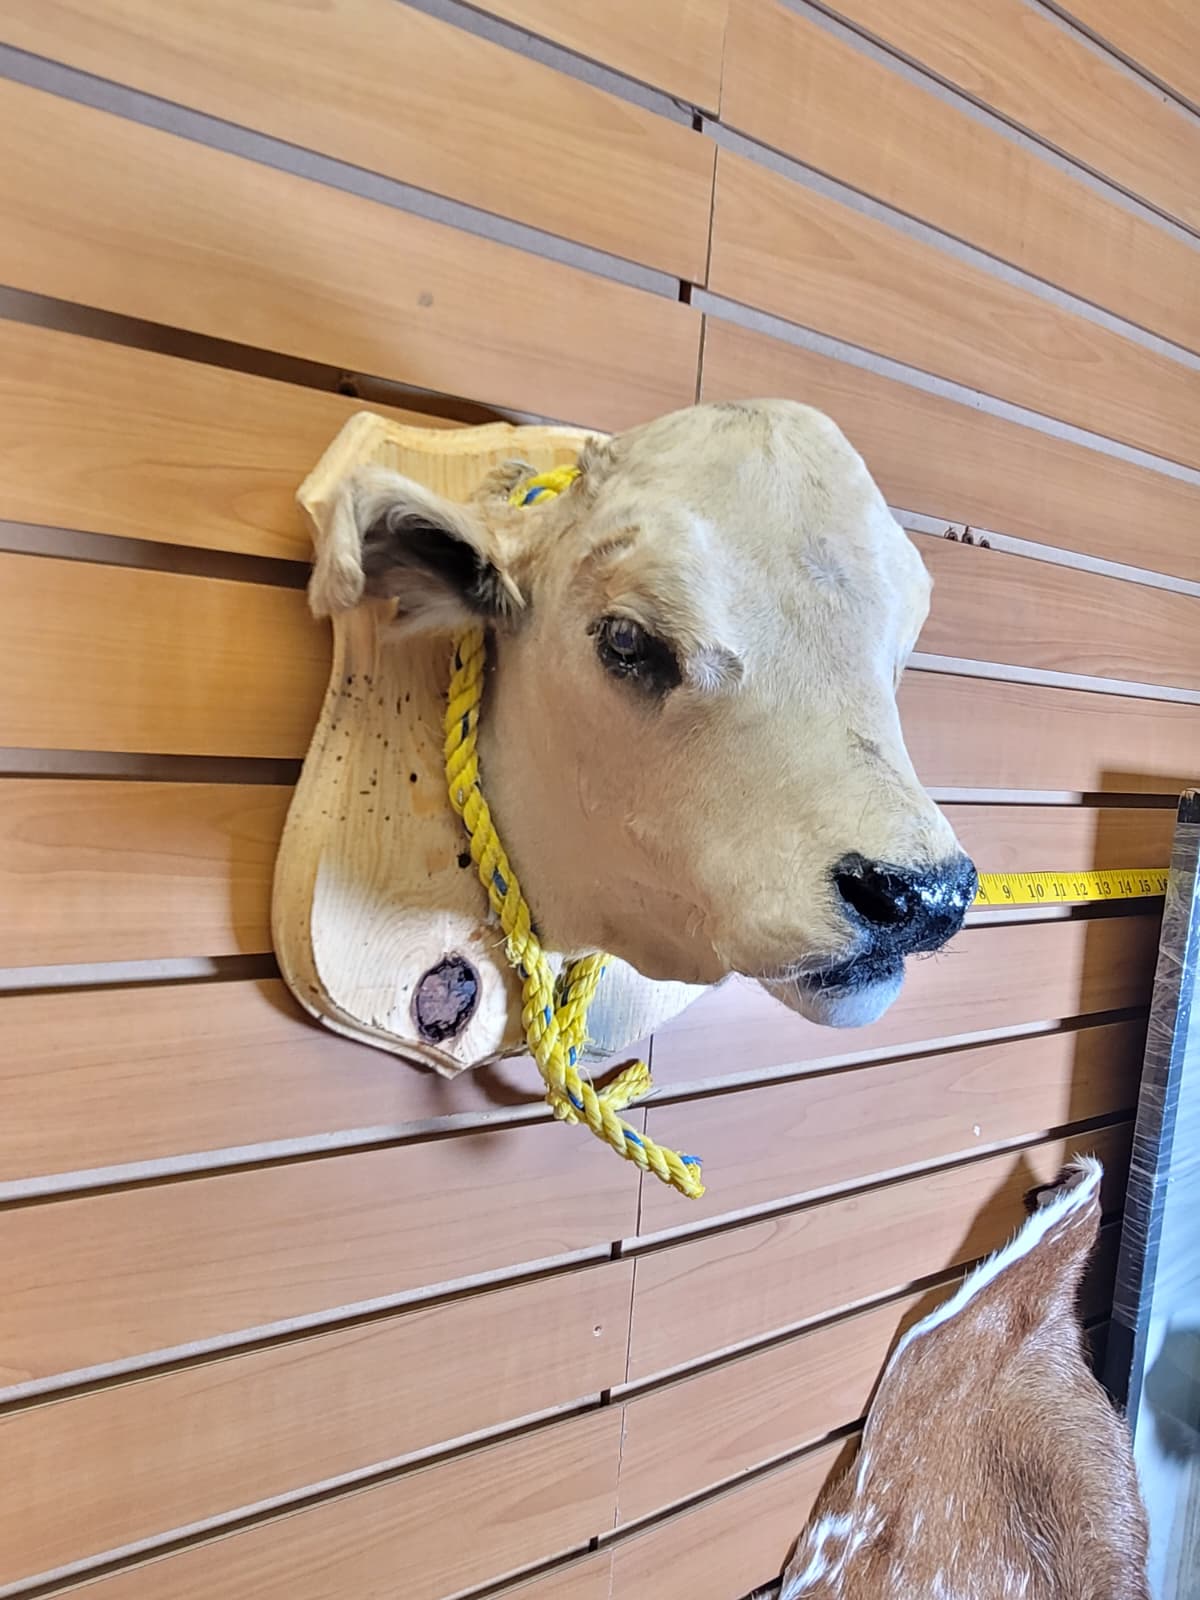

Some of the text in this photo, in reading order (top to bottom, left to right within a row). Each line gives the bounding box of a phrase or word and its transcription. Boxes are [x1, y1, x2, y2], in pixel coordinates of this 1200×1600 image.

[978, 885, 986, 899] 8
[1002, 884, 1011, 899] 9
[1027, 883, 1044, 898] 10
[1053, 883, 1067, 896] 11
[1073, 882, 1088, 896] 12
[1095, 881, 1112, 895] 13
[1118, 880, 1132, 894] 14
[1139, 879, 1151, 893] 15
